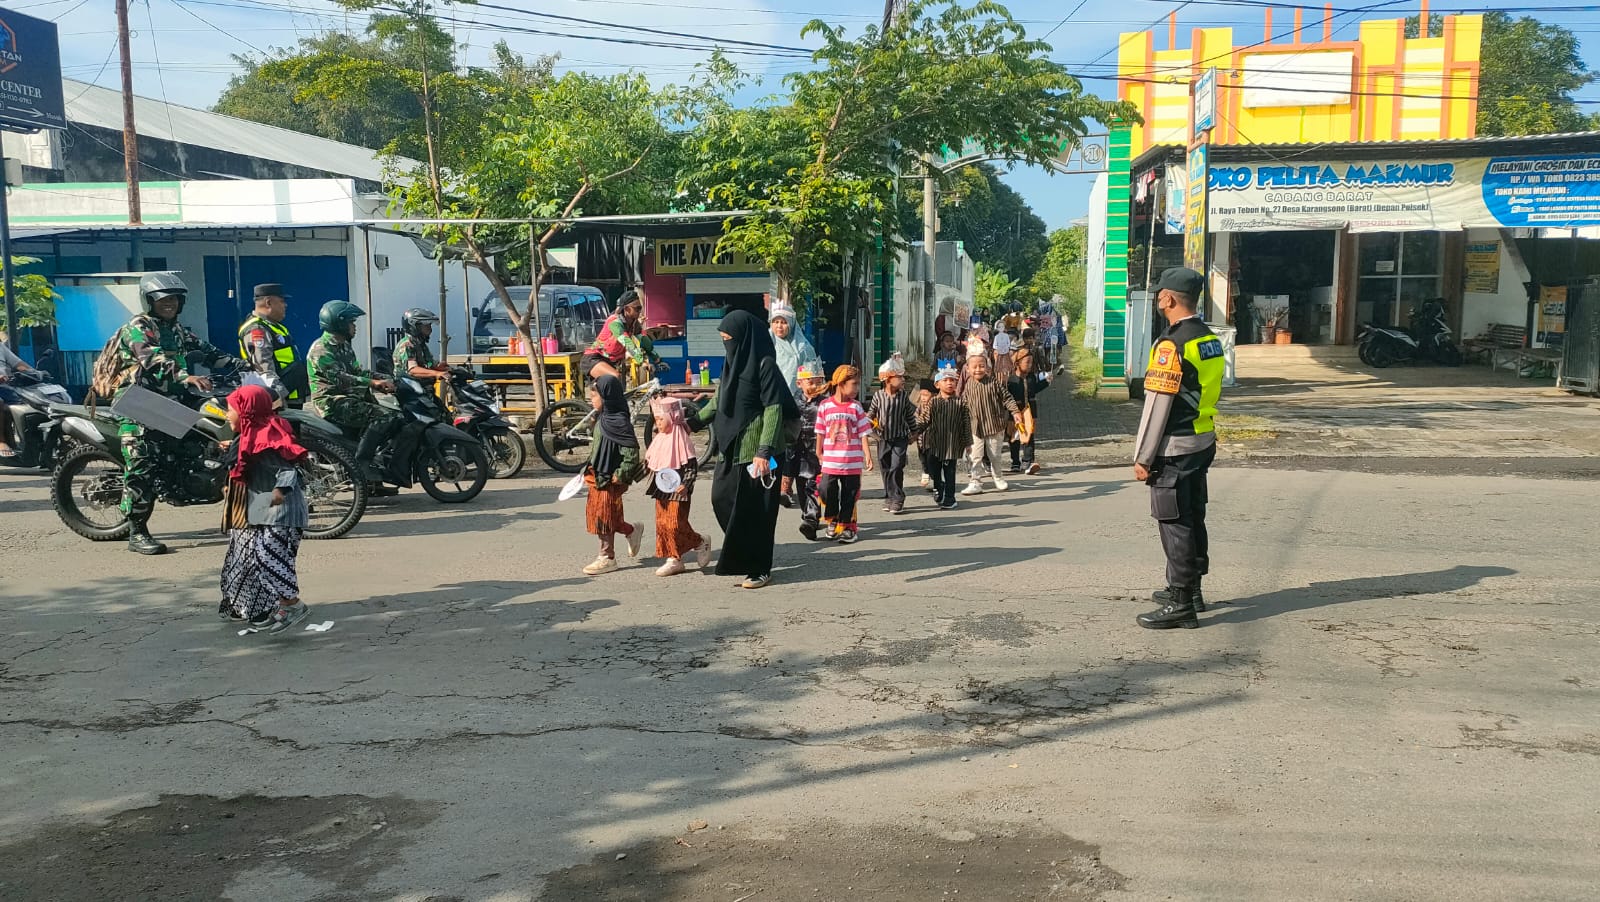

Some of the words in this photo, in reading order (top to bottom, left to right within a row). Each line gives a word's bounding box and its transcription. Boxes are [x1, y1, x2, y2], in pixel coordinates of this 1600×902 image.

[0, 50, 22, 62] TAN
[1, 80, 42, 98] CENTER
[1490, 162, 1533, 173] MELAYANI
[1534, 160, 1567, 172] GROSIR
[1568, 160, 1585, 170] DAN
[1208, 165, 1254, 190] OKO
[1257, 163, 1340, 189] PELITA
[1345, 162, 1456, 188] MAKMUR
[1527, 175, 1541, 184] WA
[1543, 174, 1564, 183] TOKO
[1564, 173, 1585, 182] 0823
[1265, 192, 1323, 202] CABANG
[1327, 192, 1373, 201] BARAT
[1494, 188, 1513, 196] TOKO
[1218, 206, 1236, 215] Raya
[1238, 205, 1260, 214] Tebon
[1272, 205, 1281, 214] 27
[1282, 204, 1301, 213] Desa
[1302, 205, 1345, 213] Karangsono
[1347, 204, 1373, 212] (Barat)
[660, 243, 687, 267] MIE
